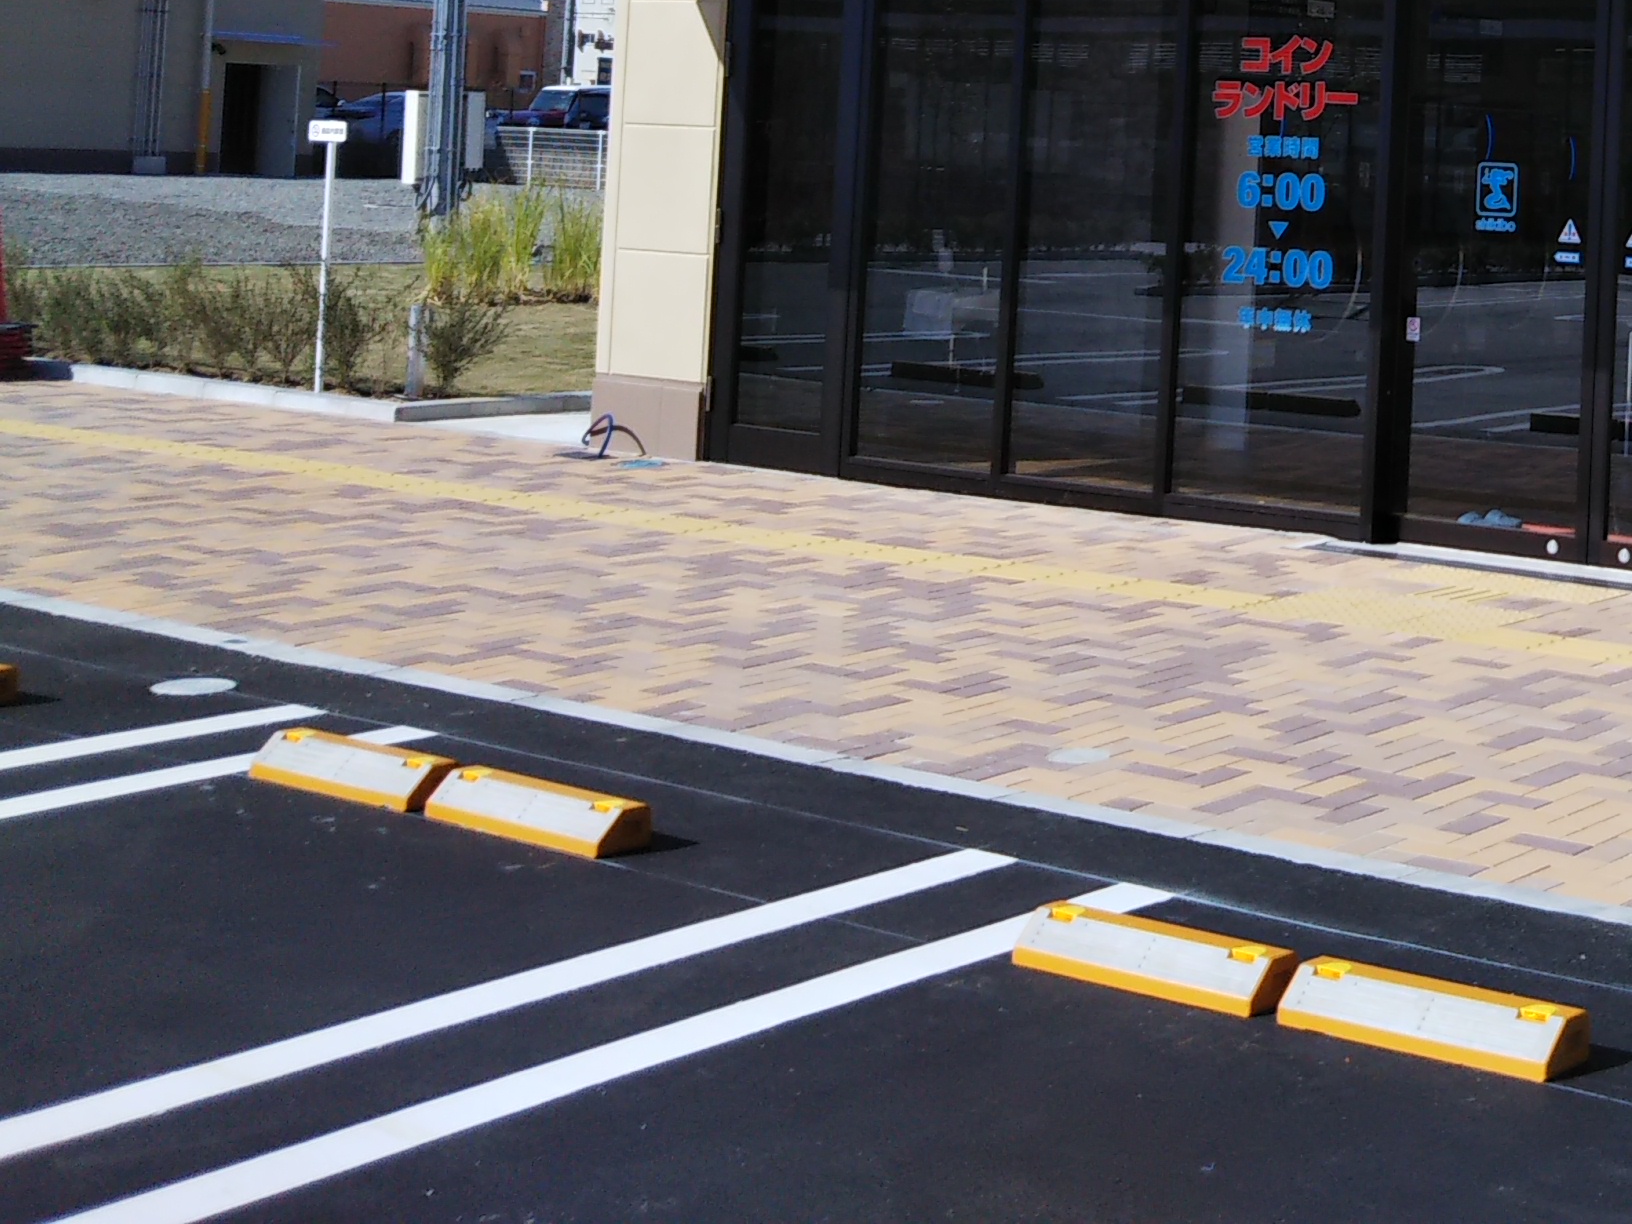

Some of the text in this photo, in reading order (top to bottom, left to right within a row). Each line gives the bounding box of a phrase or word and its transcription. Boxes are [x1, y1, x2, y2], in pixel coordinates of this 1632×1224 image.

[1240, 34, 1333, 75] コイン
[1212, 80, 1358, 121] ランドリー
[1247, 135, 1320, 159] 営業時間
[1236, 171, 1326, 212] 6:00
[1221, 245, 1334, 289] 24:00
